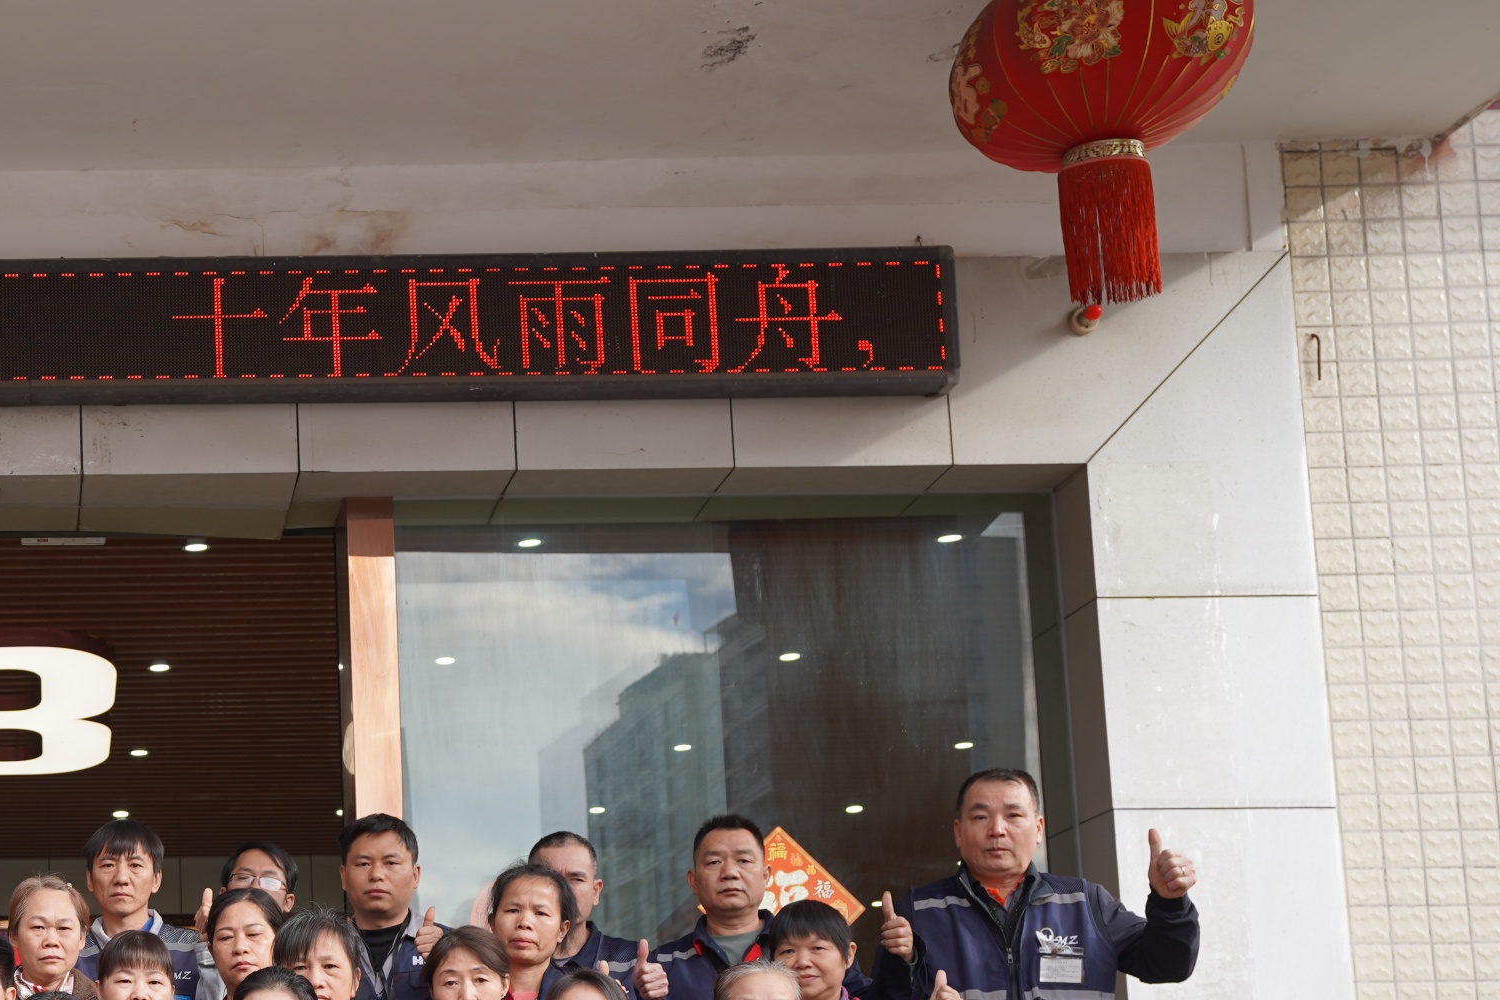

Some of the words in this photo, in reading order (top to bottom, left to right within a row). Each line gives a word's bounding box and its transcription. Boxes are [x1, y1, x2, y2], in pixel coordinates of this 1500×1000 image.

[171, 265, 877, 377] 十年风雨同舟,
[768, 842, 788, 861] 福
[814, 879, 835, 898] 福
[174, 971, 192, 980] MZ
